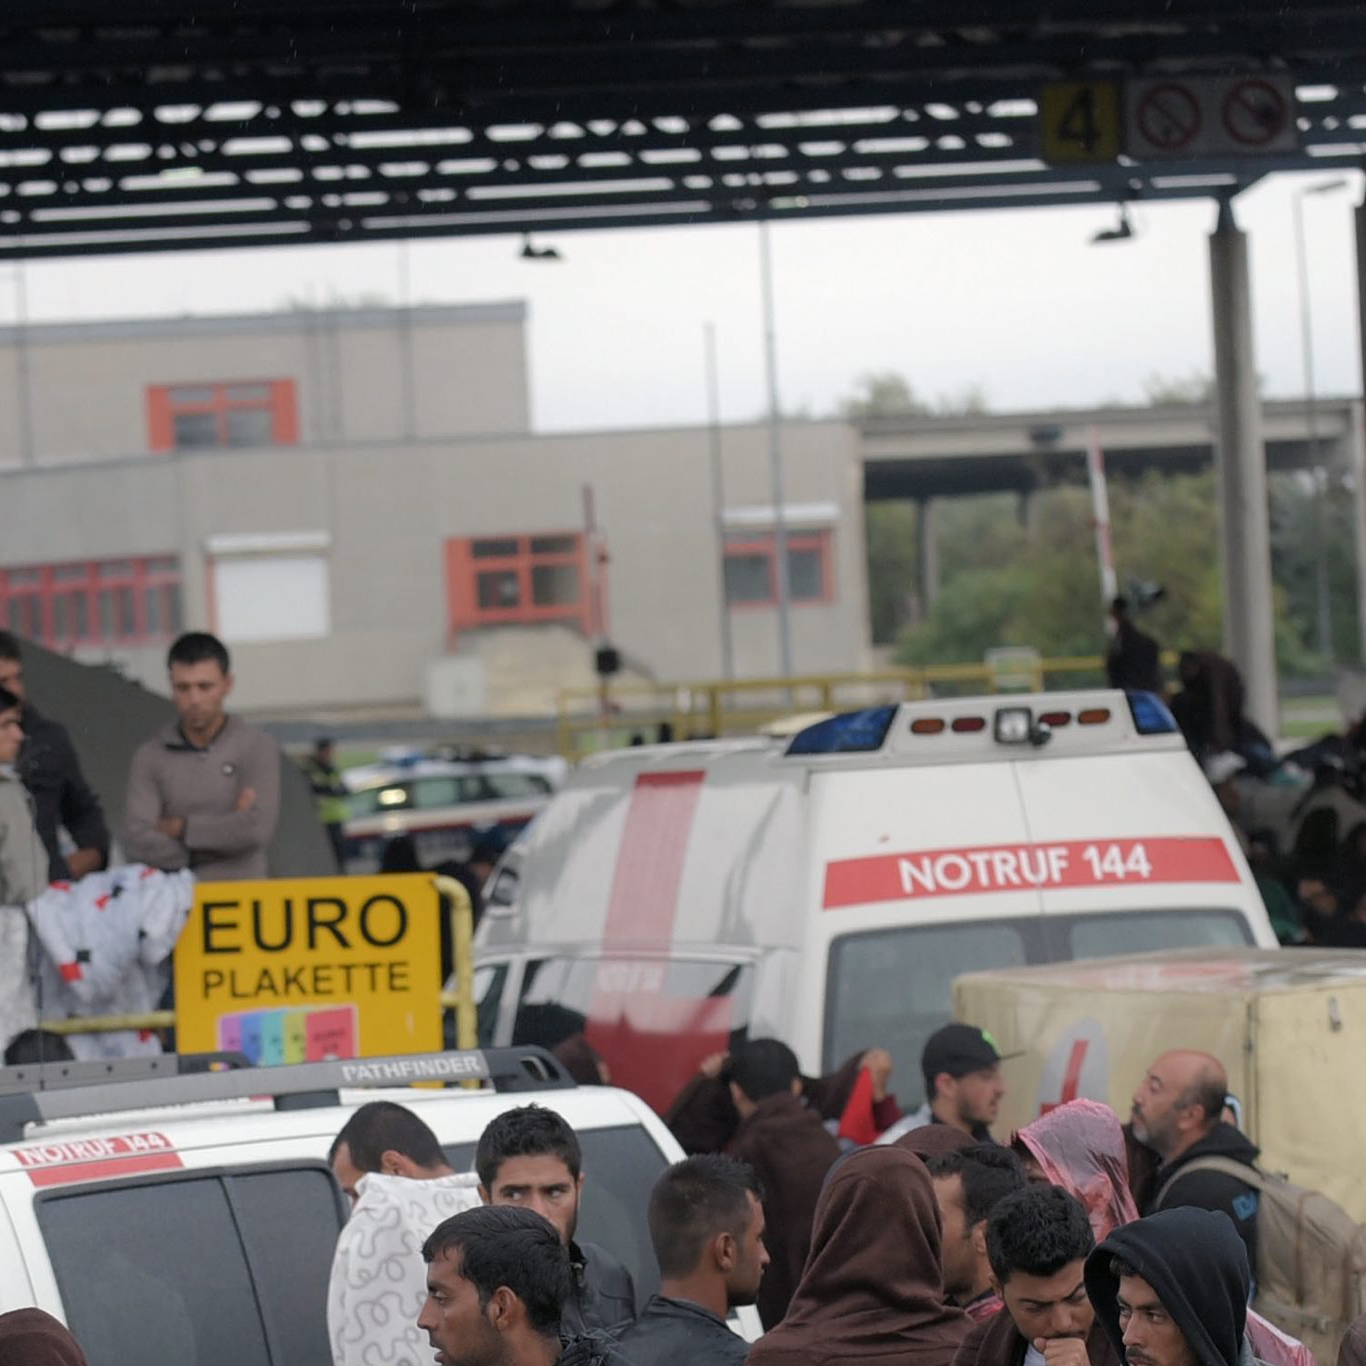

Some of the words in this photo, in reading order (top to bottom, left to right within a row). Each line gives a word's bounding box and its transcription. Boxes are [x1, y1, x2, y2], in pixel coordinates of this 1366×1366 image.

[1057, 86, 1102, 153] 4
[897, 847, 1069, 894] NOTRUF
[1081, 843, 1152, 881] 144
[201, 893, 409, 955] EURO
[202, 961, 412, 999] PLAKETTE
[341, 1055, 482, 1082] PATHFINDER
[24, 1137, 116, 1166] NOTRUF
[123, 1132, 166, 1153] 144
